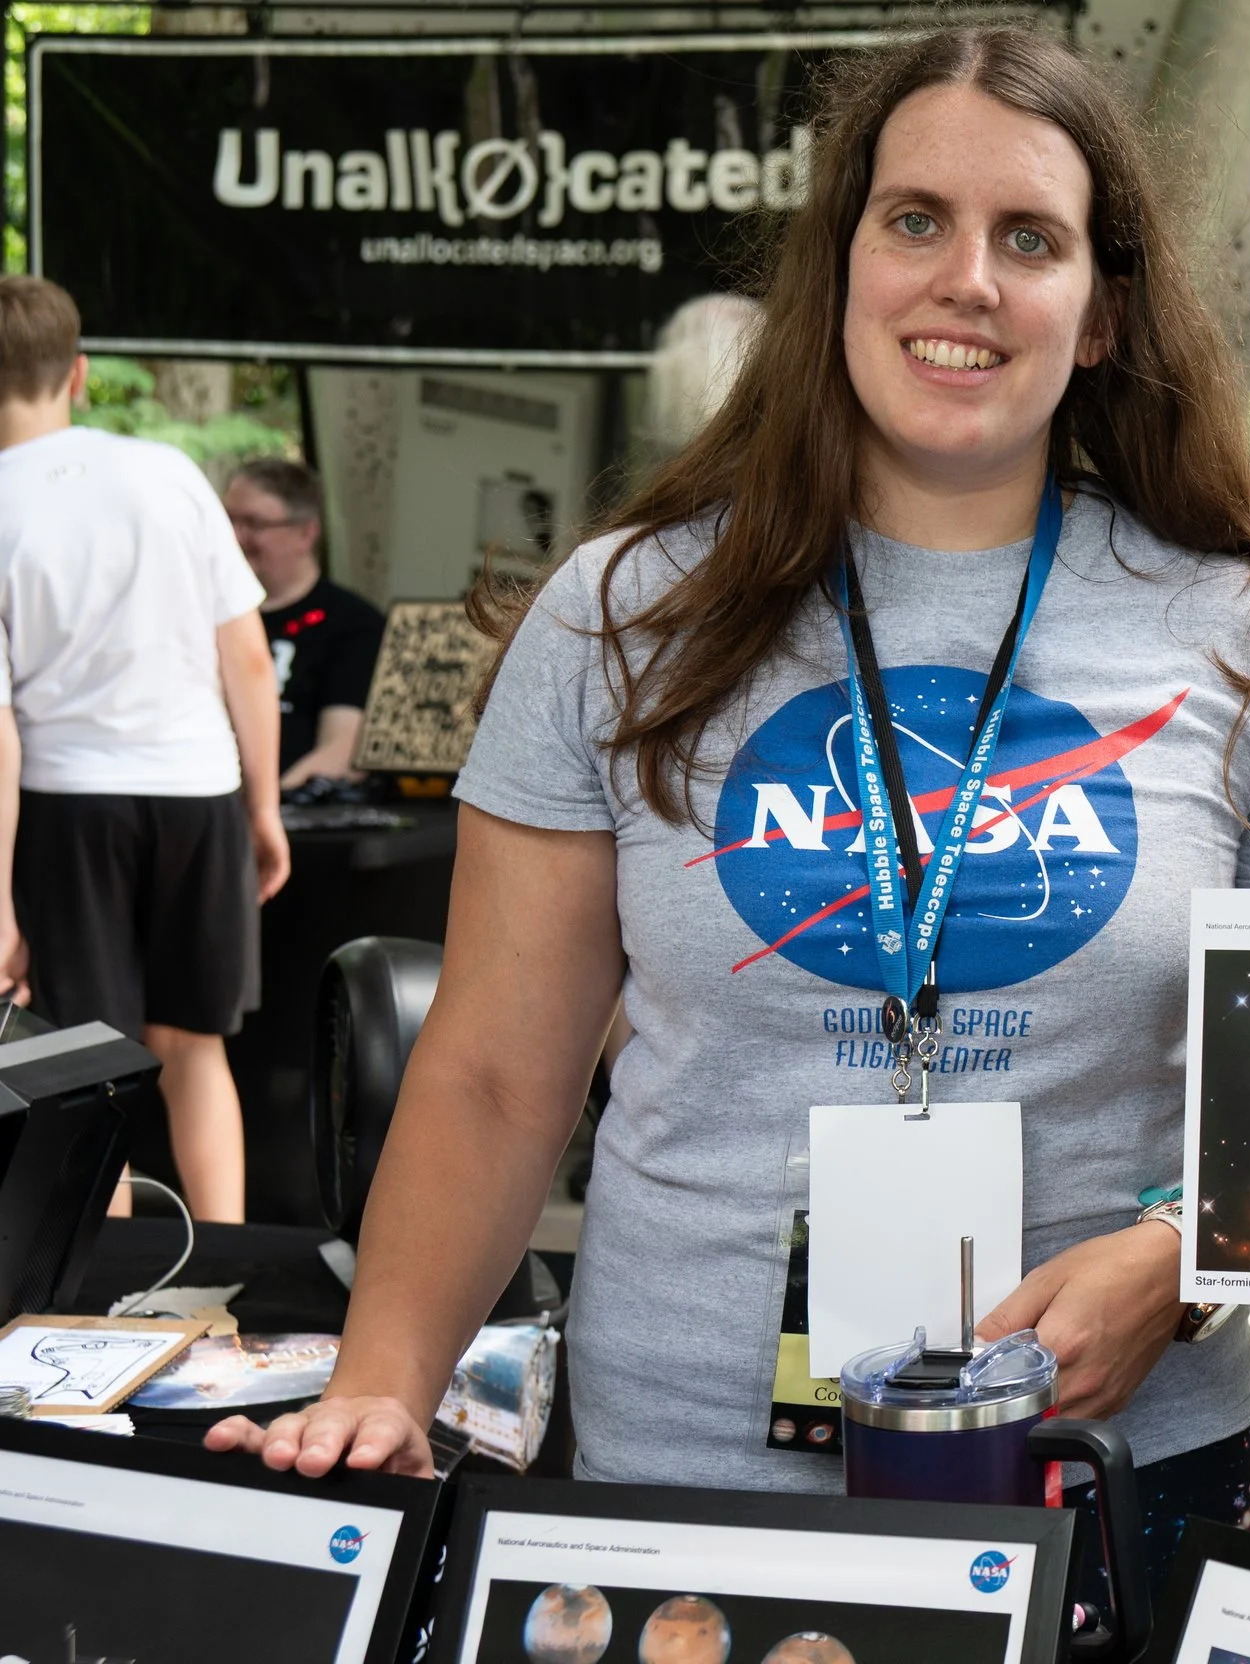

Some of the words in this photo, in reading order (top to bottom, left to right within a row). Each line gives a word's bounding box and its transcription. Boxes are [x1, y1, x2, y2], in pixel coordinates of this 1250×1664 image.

[360, 233, 662, 273] unallocatedspace.org
[854, 672, 874, 767] Telescop
[971, 708, 1001, 774] Hubble
[741, 783, 1121, 854] NSA
[865, 771, 888, 832] Space
[951, 778, 981, 838] Space
[872, 836, 895, 911] Hubble
[916, 844, 962, 951] Telescope
[953, 1008, 1033, 1038] SPACE
[498, 1537, 526, 1546] National
[527, 1539, 568, 1549] Aeronautics
[569, 1542, 583, 1550] and
[585, 1543, 608, 1552] Space
[609, 1544, 661, 1555] Administration
[972, 1566, 1007, 1578] NASA
